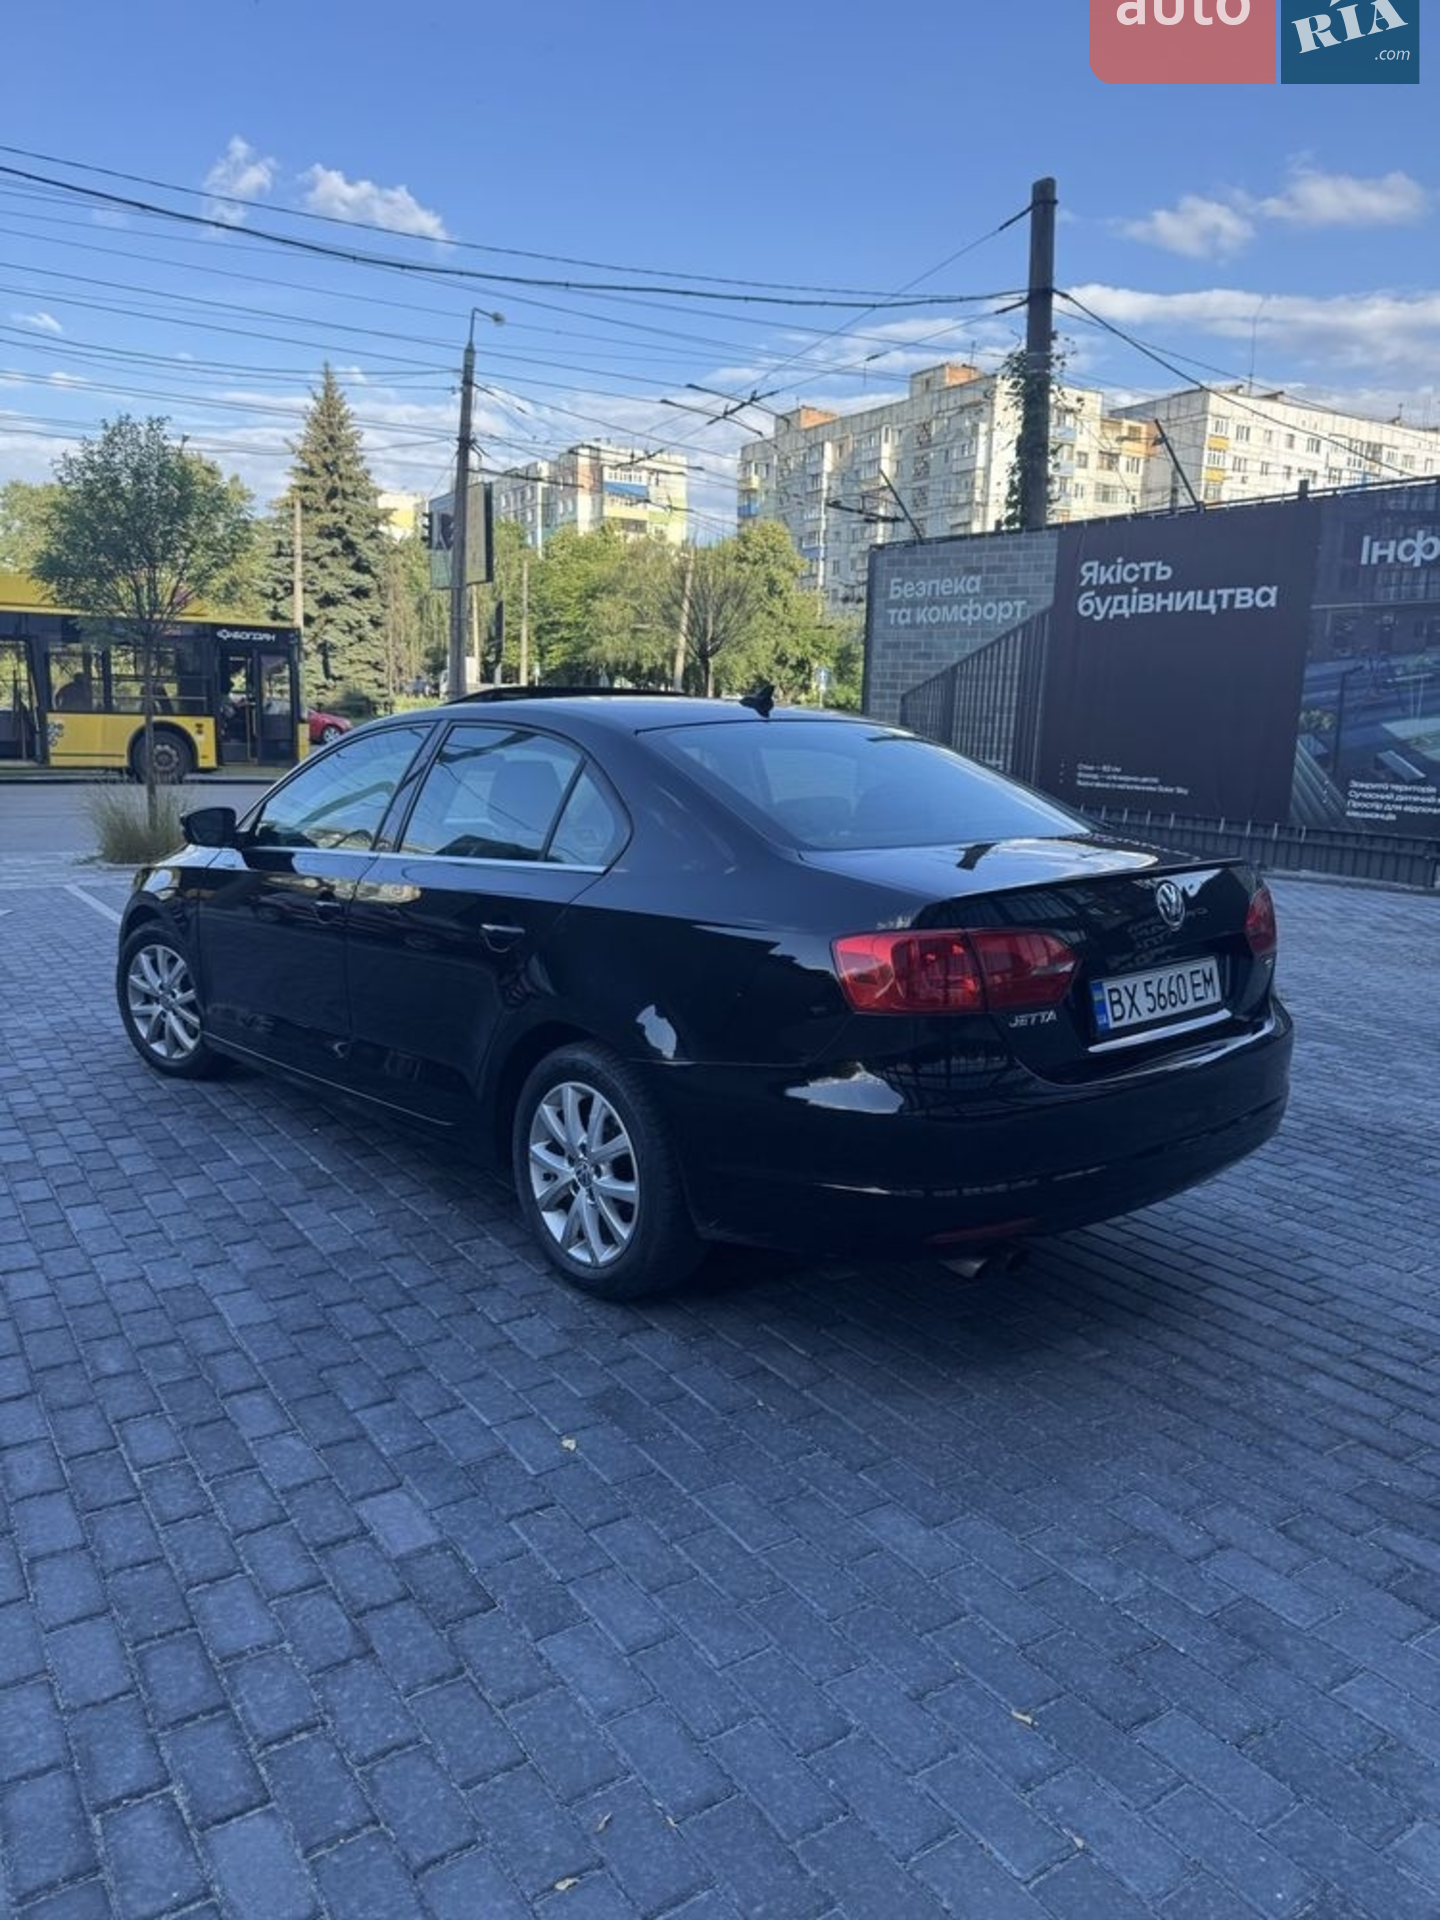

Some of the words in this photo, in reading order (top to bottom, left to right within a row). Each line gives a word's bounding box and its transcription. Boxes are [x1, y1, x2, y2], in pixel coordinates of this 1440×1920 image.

[1080, 557, 1173, 586] Якість
[889, 576, 982, 600] Безпека
[886, 607, 911, 625] та
[916, 598, 1027, 626] комфорт
[1078, 587, 1278, 621] будівництва
[1107, 984, 1142, 1022] BX
[1144, 974, 1188, 1014] 5660
[1190, 967, 1217, 1001] EM
[1008, 1010, 1057, 1028] JETTA
